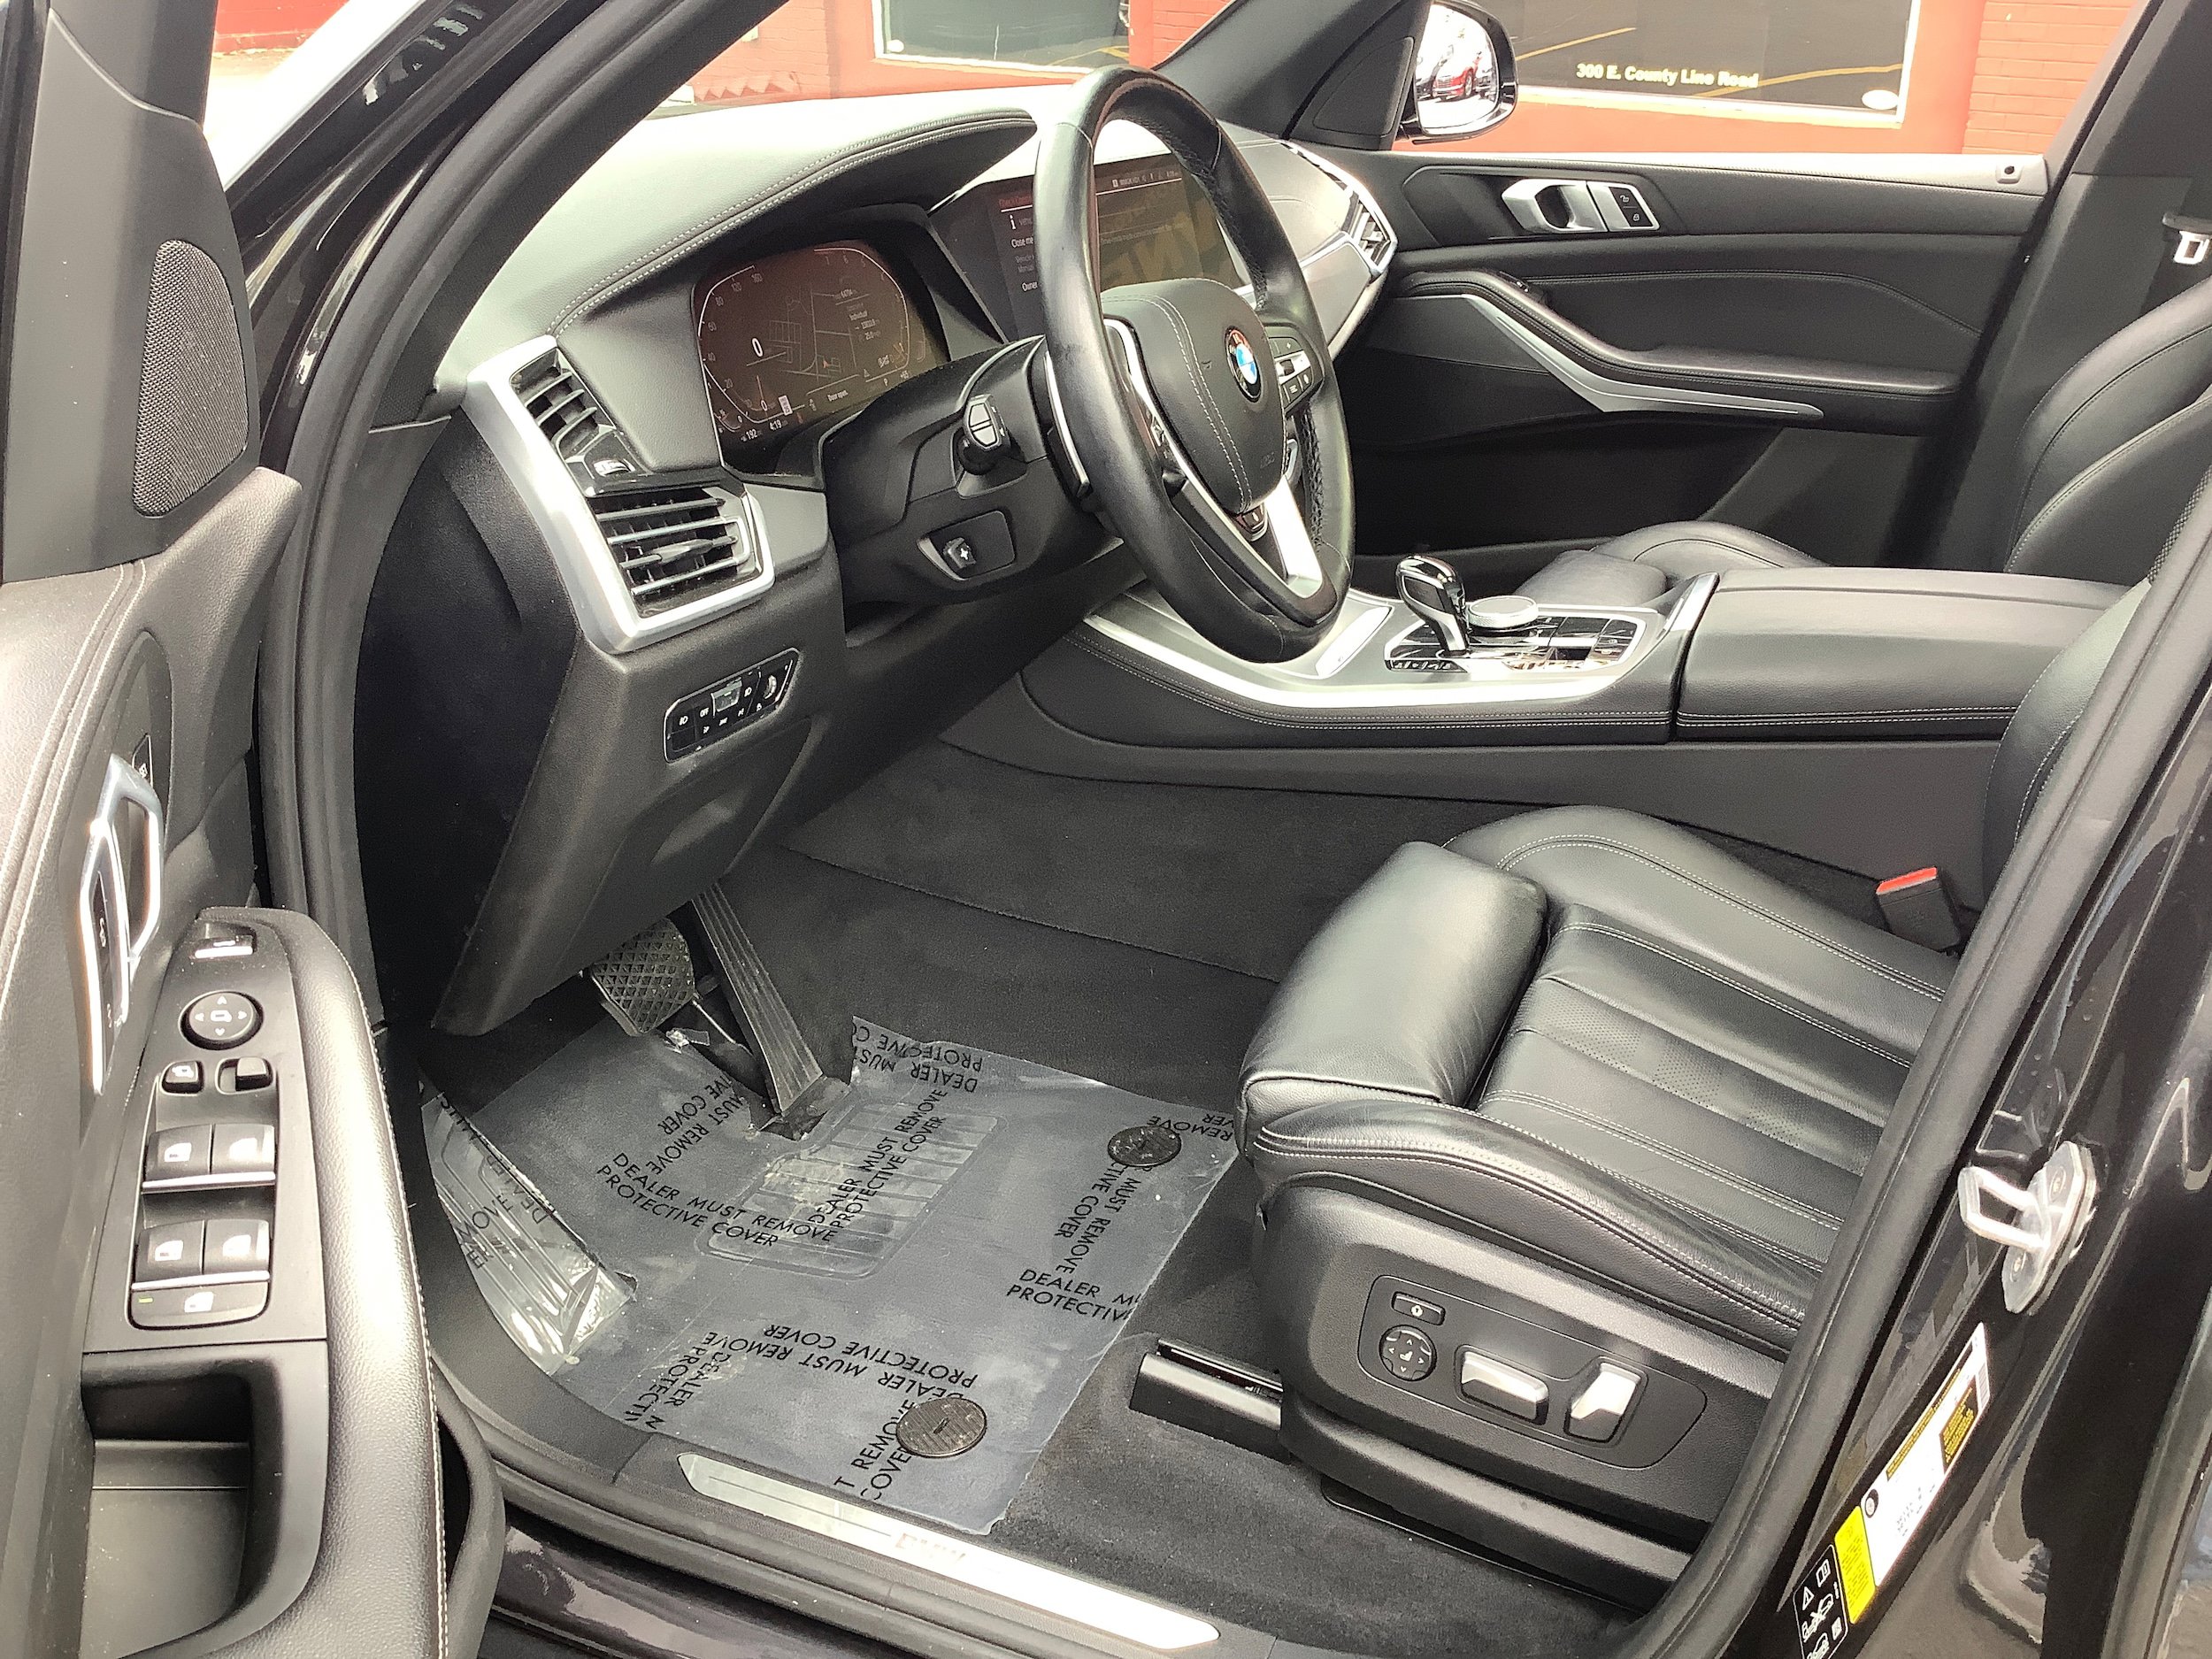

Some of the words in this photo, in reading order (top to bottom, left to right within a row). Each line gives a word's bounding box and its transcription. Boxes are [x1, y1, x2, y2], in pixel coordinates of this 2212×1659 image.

[1624, 66, 1678, 86] County
[1680, 69, 1715, 85] Line
[1717, 71, 1759, 88] Road
[751, 337, 764, 357] 0
[854, 1046, 896, 1073] MUS
[877, 1033, 984, 1073] PROTECTIVE
[910, 1061, 978, 1094] DEALER
[657, 1094, 707, 1136] COVER
[858, 1136, 899, 1172] MUST
[894, 1088, 949, 1133] REMOVE
[1146, 1115, 1233, 1142] REMOVE
[645, 1123, 710, 1176] REMOVE
[829, 1155, 908, 1229] PROTECTIVE
[902, 1116, 948, 1153] COVER
[596, 1164, 709, 1228] PROTECTIVE
[710, 1221, 780, 1248] COVER
[612, 1152, 680, 1202] DEALER
[686, 1195, 748, 1221] MUST
[751, 1213, 839, 1243] REMOVE
[1103, 1177, 1142, 1213] MUST
[1054, 1195, 1100, 1239] COVER
[1055, 1217, 1111, 1275] REMOVE
[1018, 1268, 1101, 1298] DEALER
[701, 1331, 794, 1361] REMOVE
[763, 1324, 837, 1349] COVER
[664, 1351, 733, 1408] DEALER
[799, 1353, 868, 1378] MUST
[841, 1340, 979, 1389] PROTECTIVE
